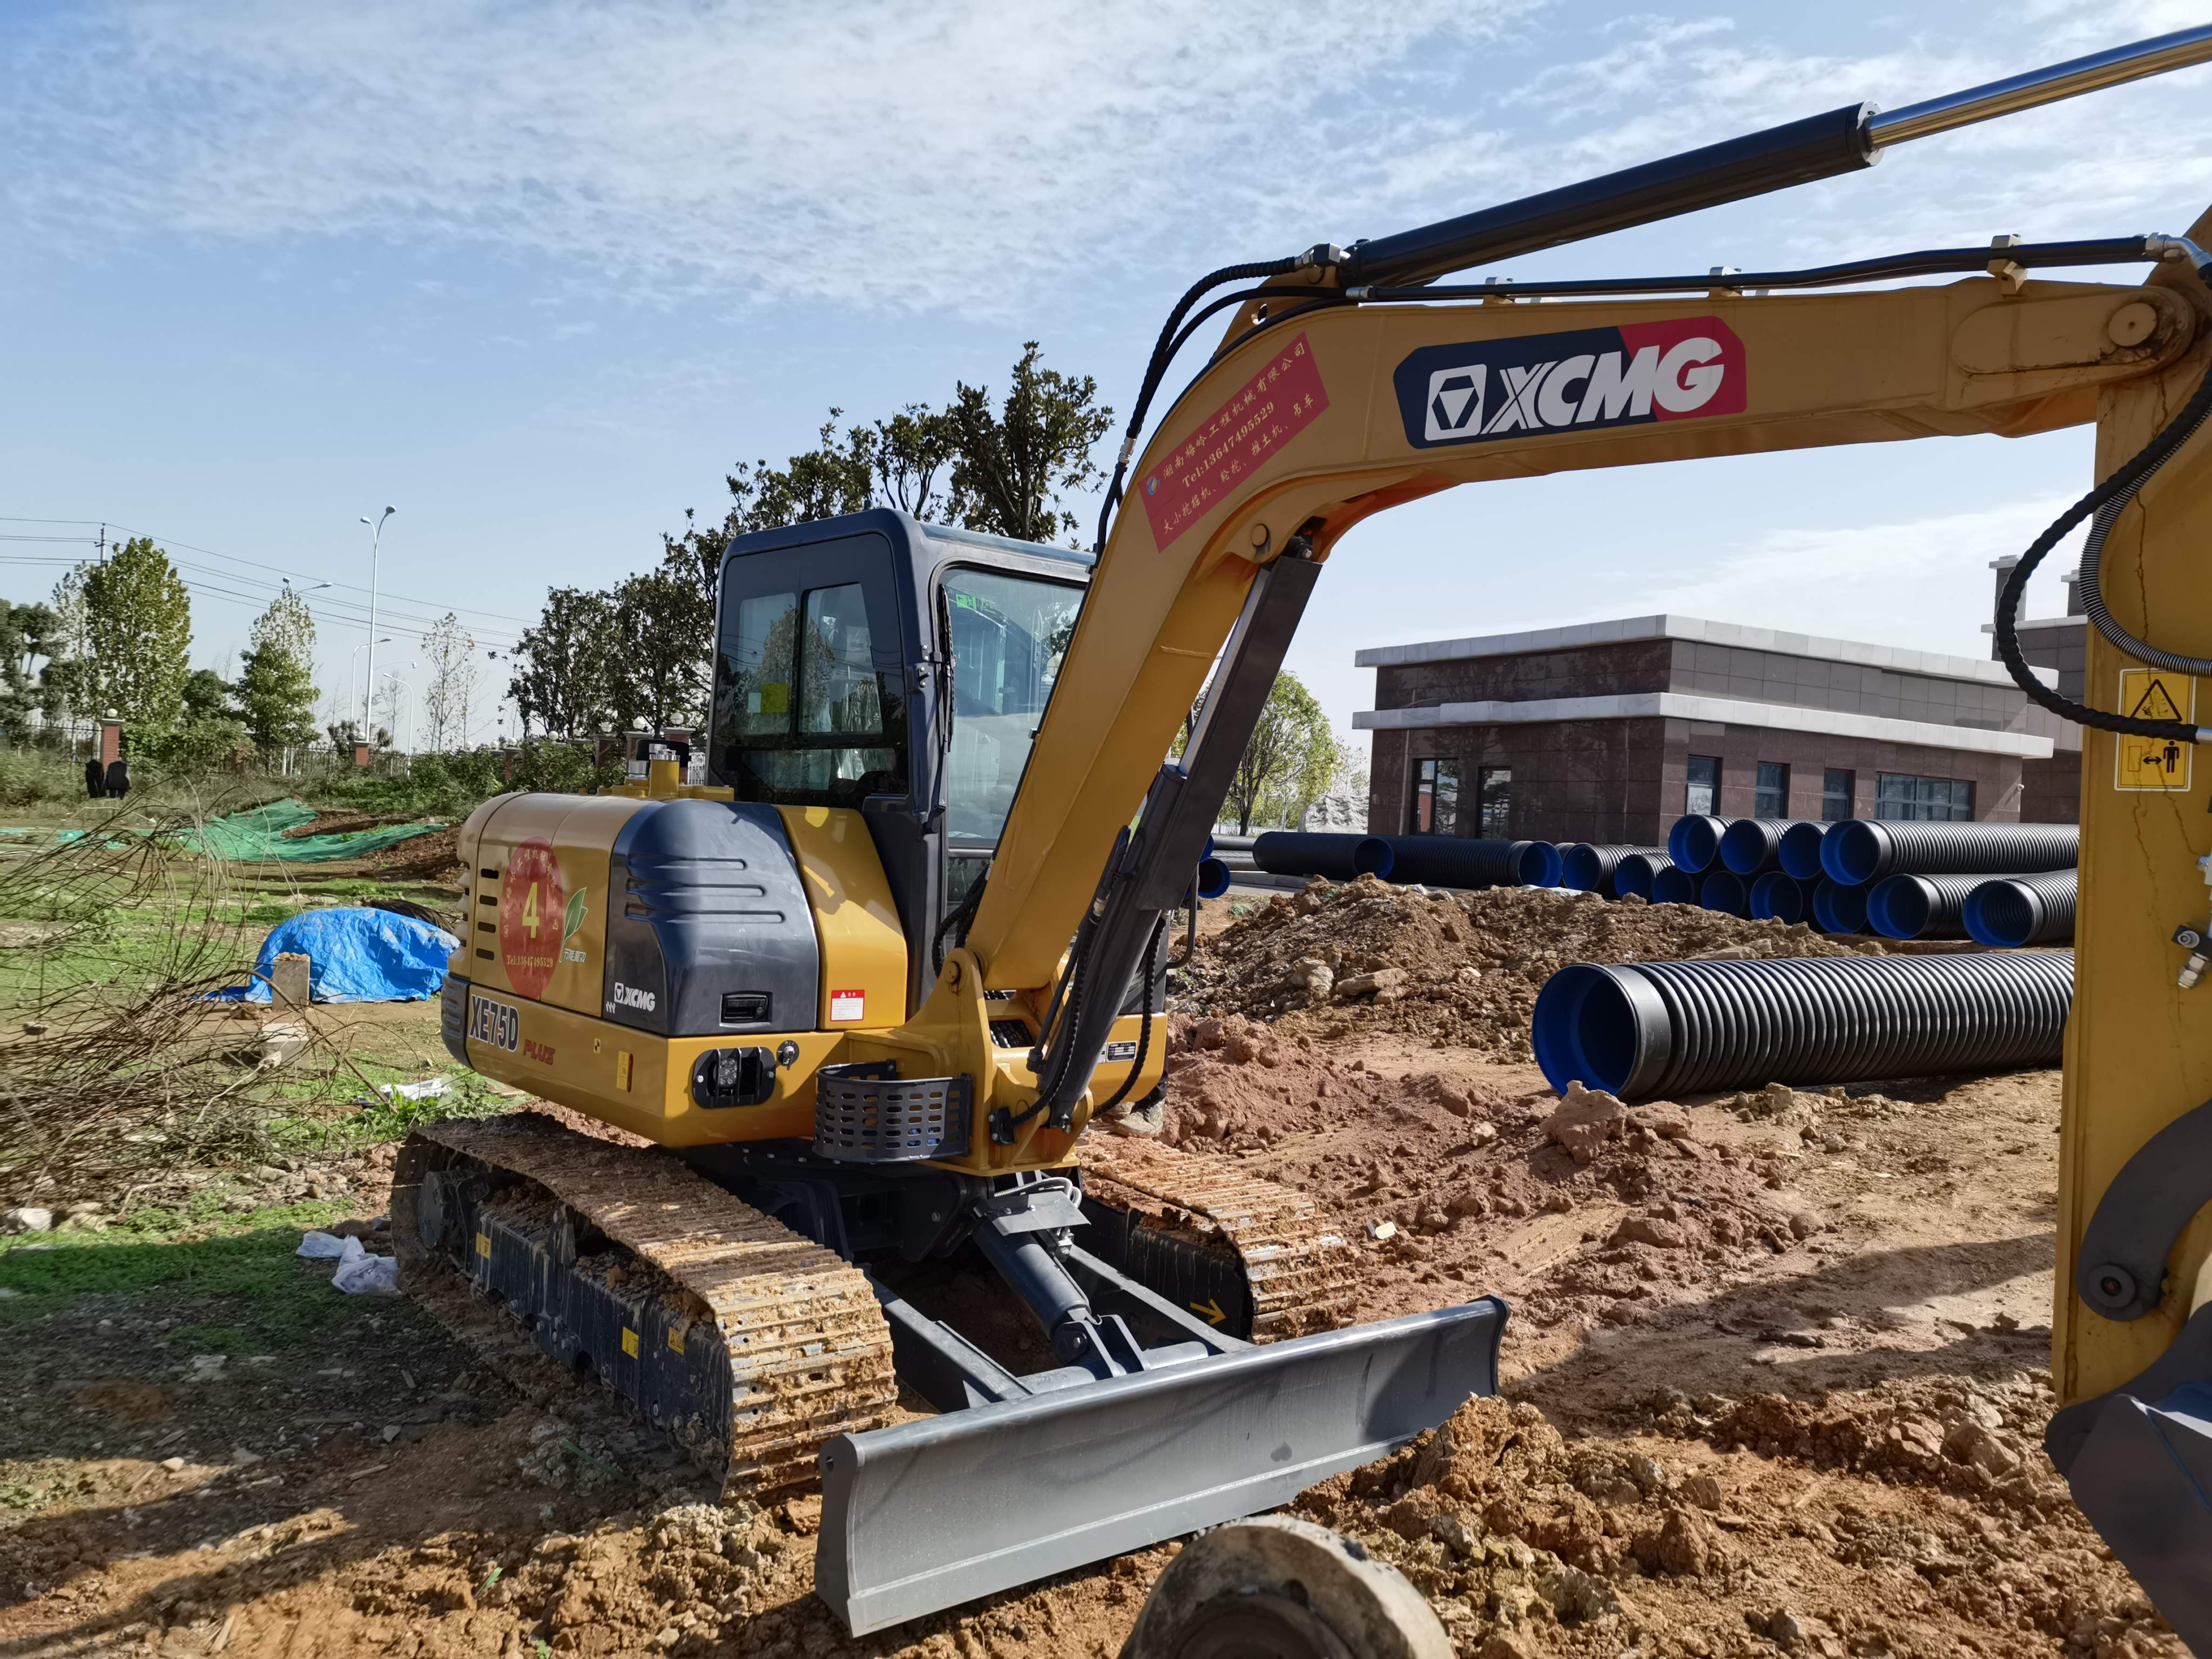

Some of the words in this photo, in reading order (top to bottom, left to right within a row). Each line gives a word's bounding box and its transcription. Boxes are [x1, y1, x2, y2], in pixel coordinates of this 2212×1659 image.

[1163, 342, 1305, 479] 湖南梅岭工程机械有限公司
[1480, 337, 1724, 435] XCMG
[1182, 401, 1275, 489] Tel:13647495529
[522, 882, 540, 939] 4
[469, 994, 520, 1053] XE75D
[523, 1039, 556, 1065] PLUS
[623, 987, 656, 1011] XCMG
